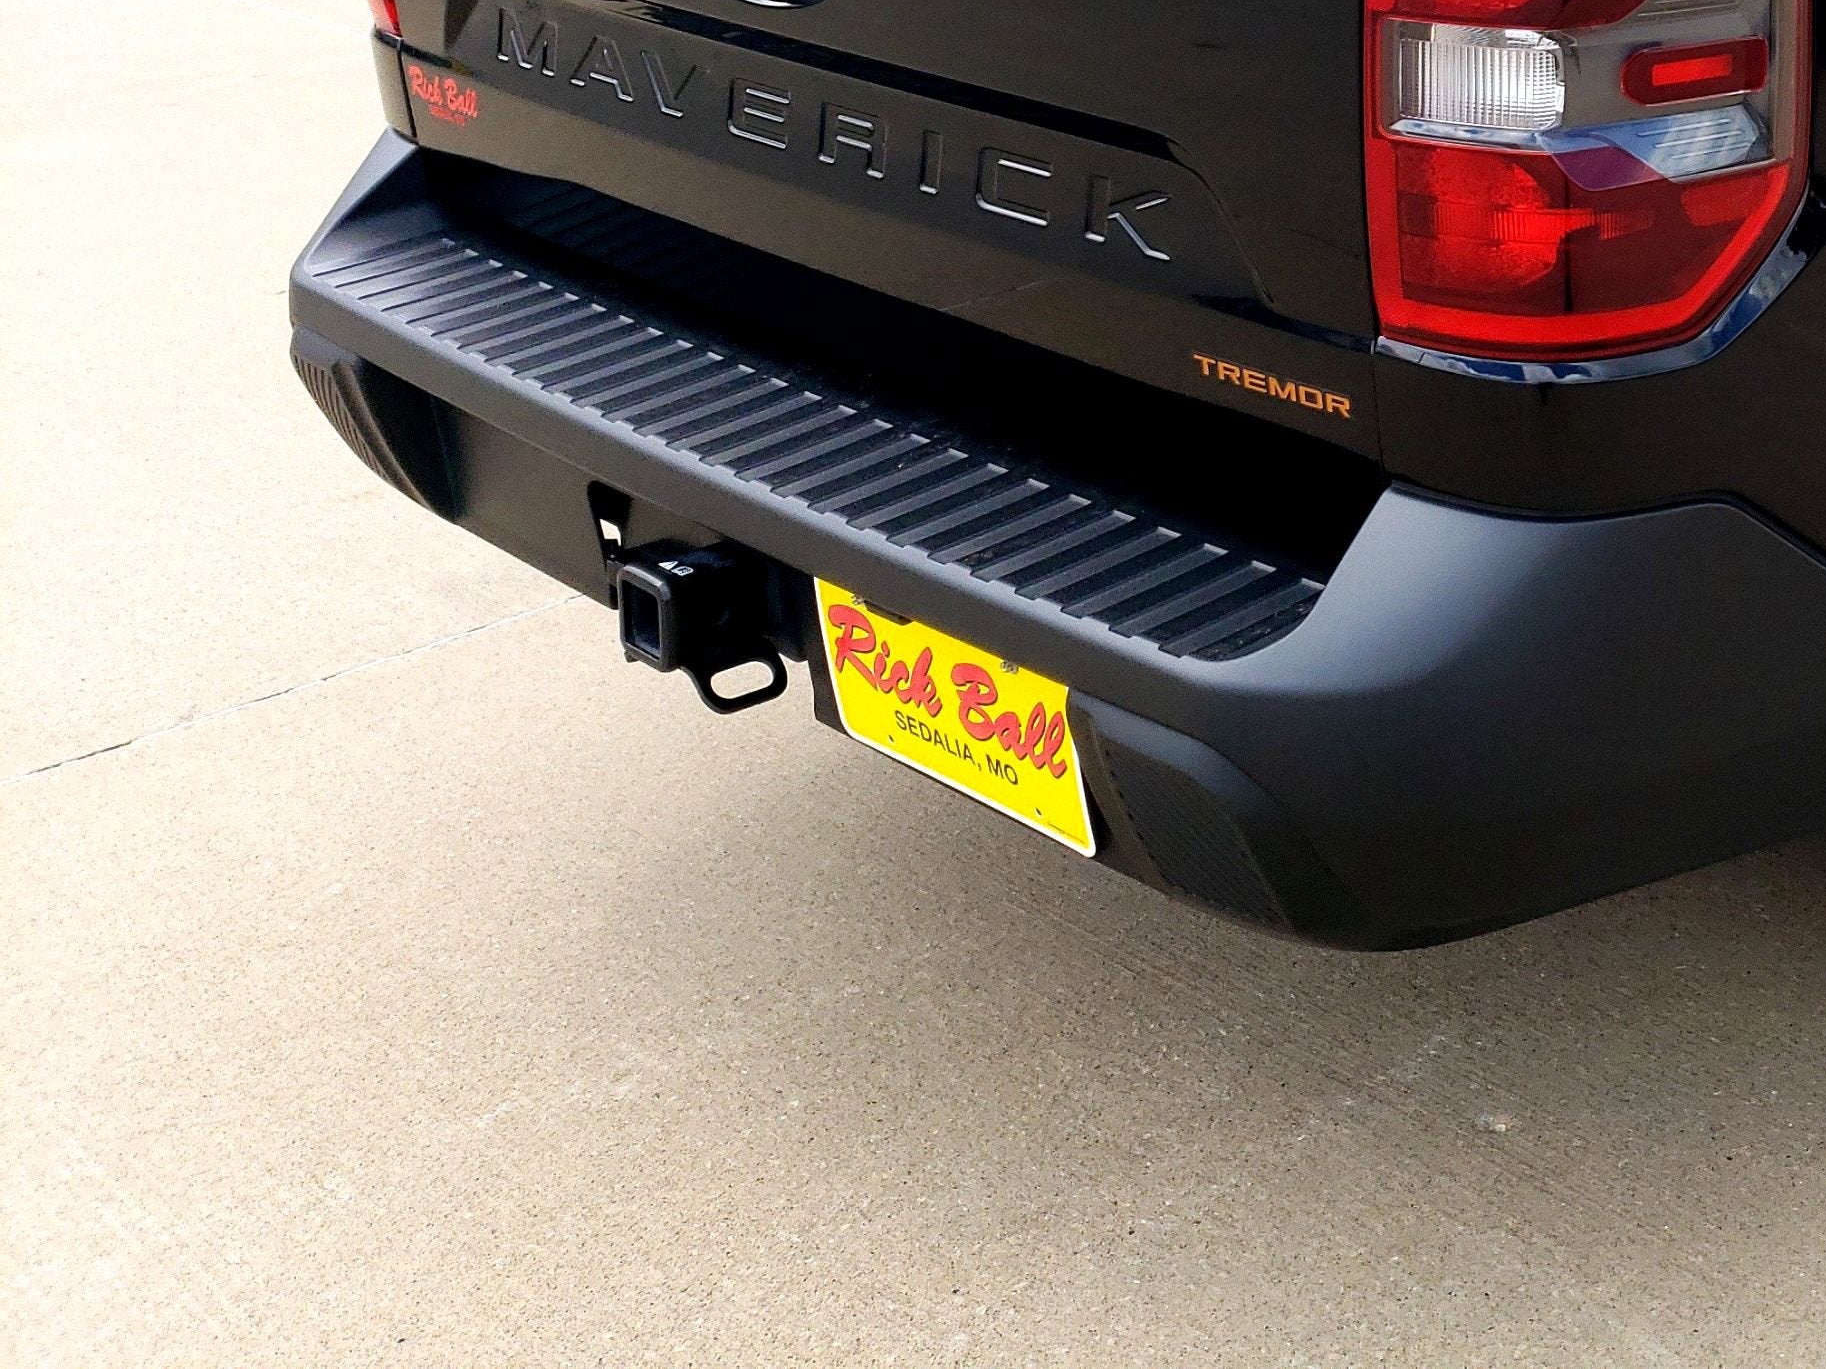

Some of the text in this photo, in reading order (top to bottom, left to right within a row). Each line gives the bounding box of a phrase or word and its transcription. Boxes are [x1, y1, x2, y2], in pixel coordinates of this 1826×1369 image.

[407, 65, 443, 106] Rick
[444, 77, 478, 118] Ball
[496, 7, 1172, 261] MAVERICK
[1192, 352, 1351, 419] TREMOR
[827, 603, 1068, 779] Rick Ball
[894, 709, 1019, 786] SEDALIA, MO
